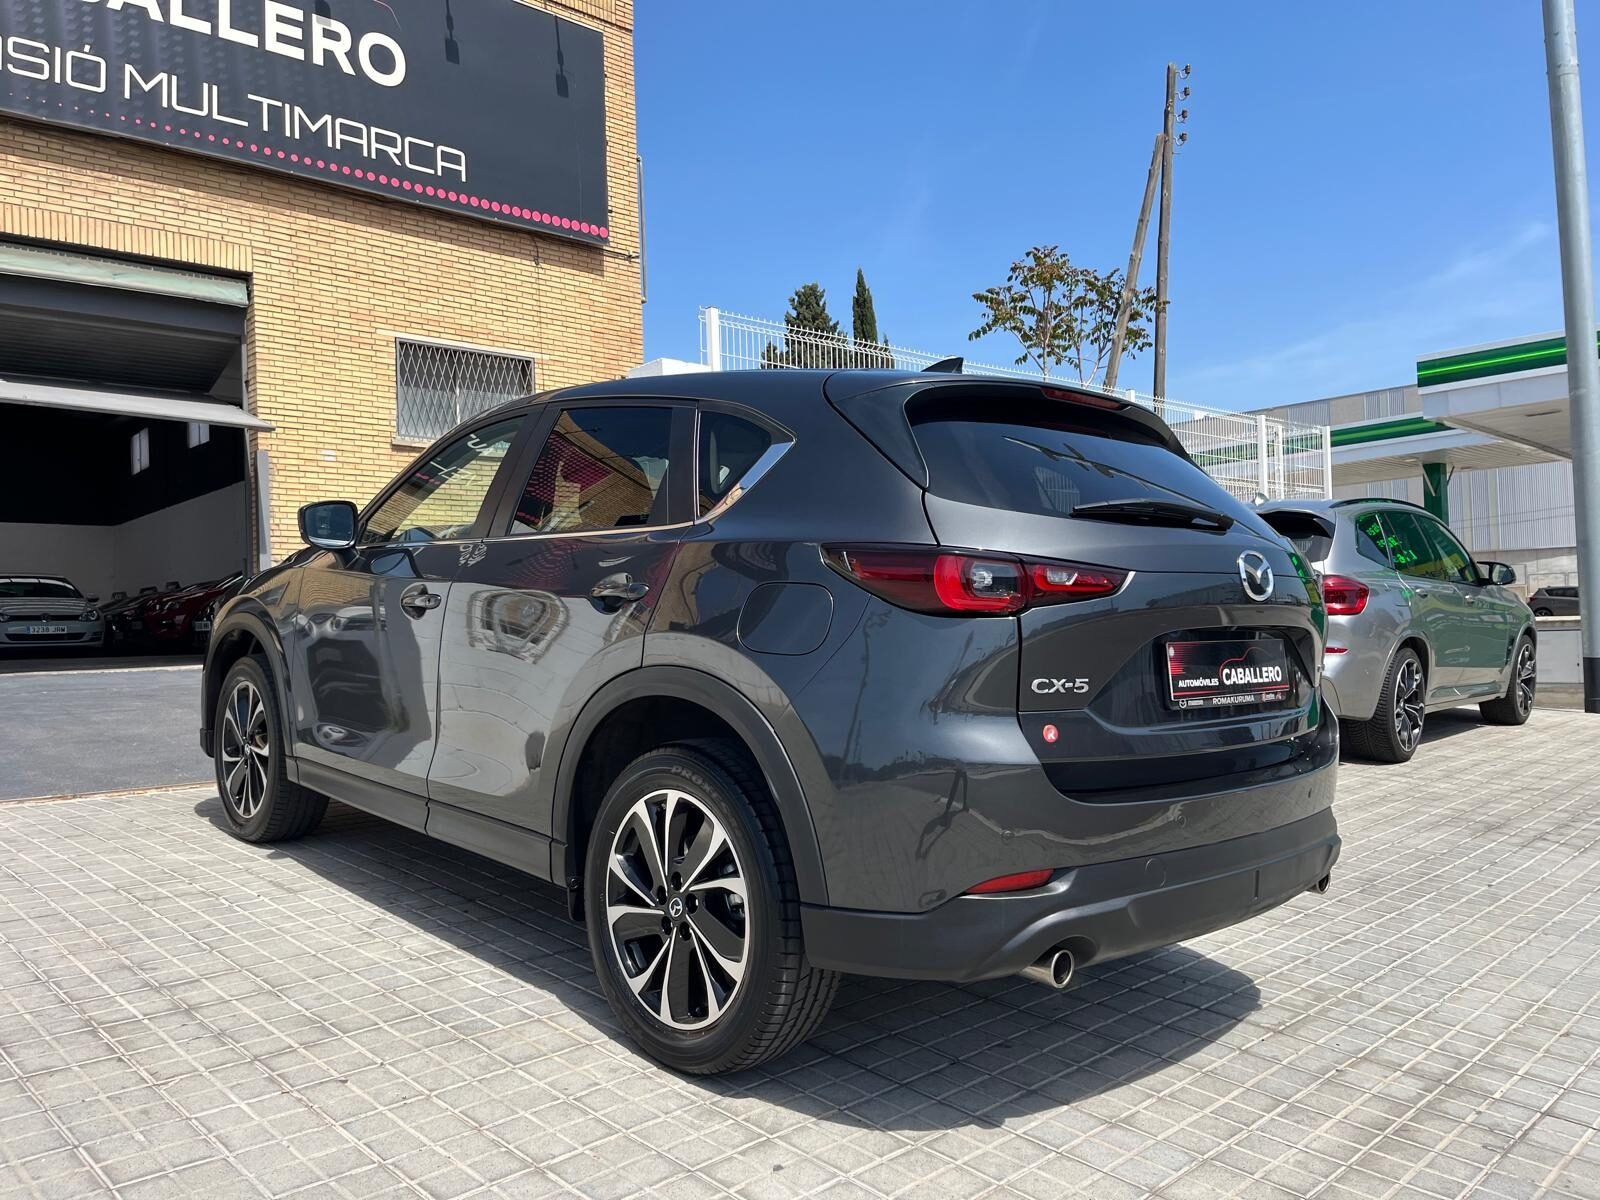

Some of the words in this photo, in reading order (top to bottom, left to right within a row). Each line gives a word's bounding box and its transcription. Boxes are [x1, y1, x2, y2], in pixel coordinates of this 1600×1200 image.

[82, 0, 407, 87] LLERO
[0, 35, 107, 94] SIÓ
[124, 63, 467, 183] MULTIMARCA
[1031, 678, 1089, 694] CX-5
[1178, 677, 1219, 688] AUTOMÓVILES
[1222, 665, 1282, 685] CABALLERO
[1212, 695, 1255, 705] ROMAKURUMA
